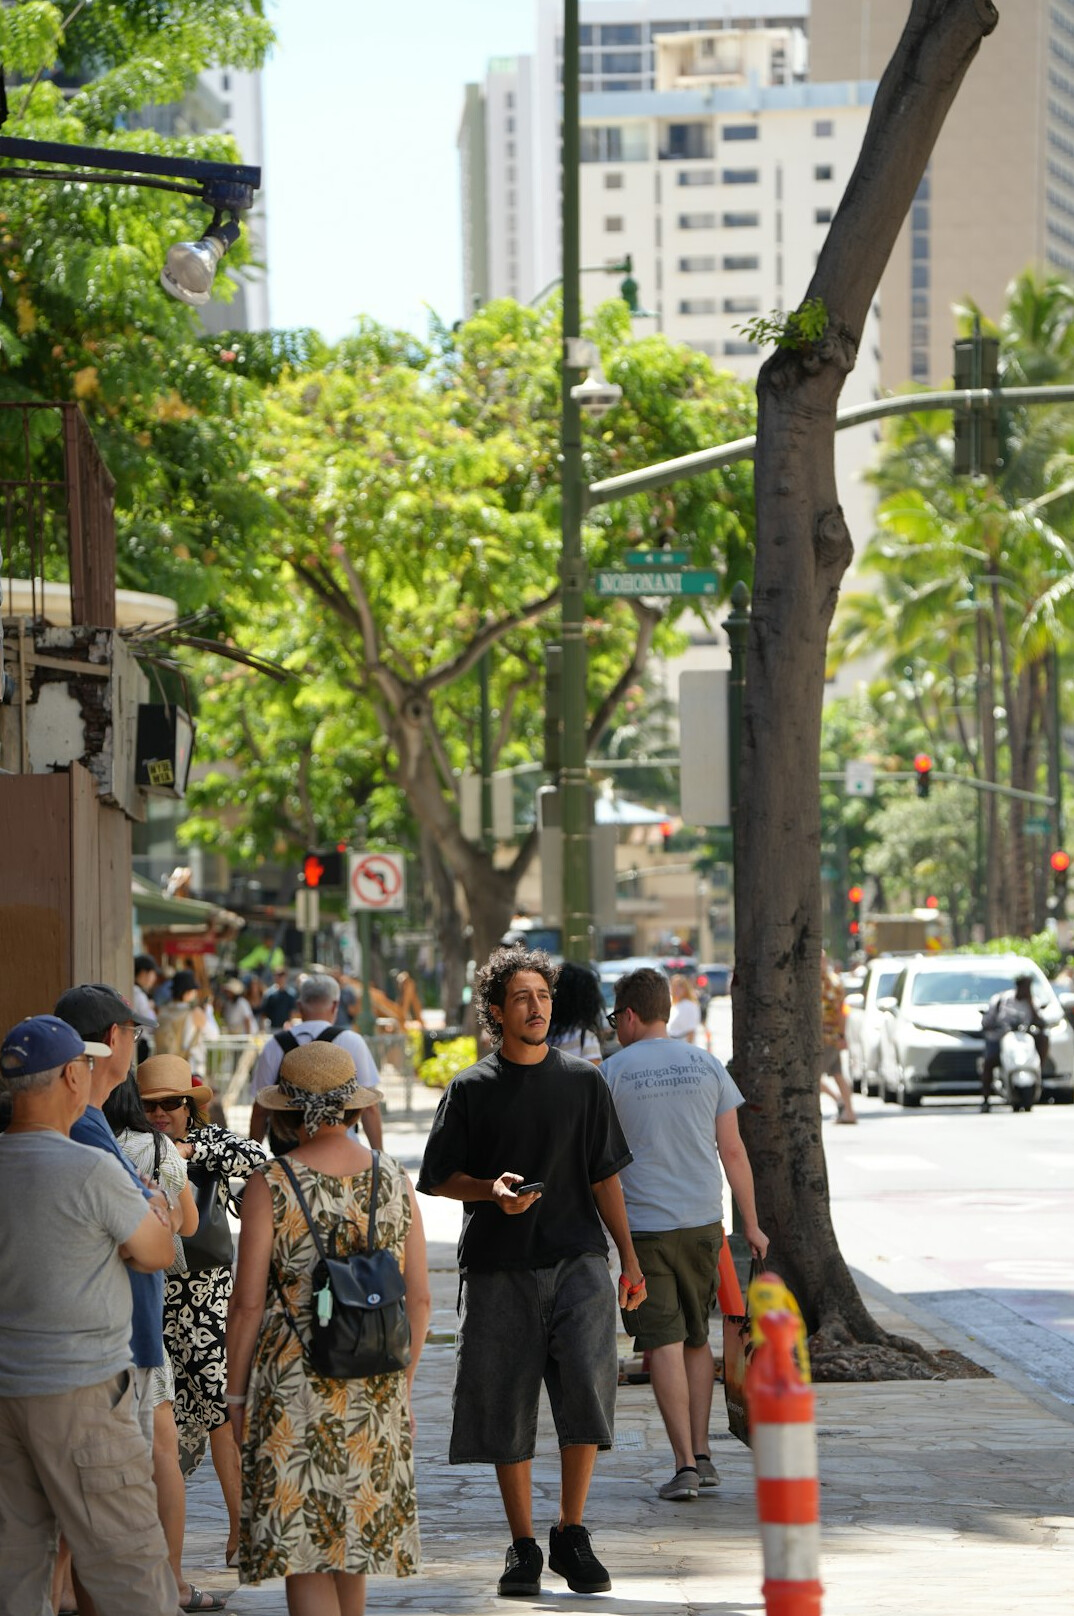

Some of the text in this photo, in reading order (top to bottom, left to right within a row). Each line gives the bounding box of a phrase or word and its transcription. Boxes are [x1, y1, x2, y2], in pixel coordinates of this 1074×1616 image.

[600, 572, 682, 592] NOHONANI
[621, 1068, 669, 1081] Saratoga
[645, 1075, 701, 1088] Company
